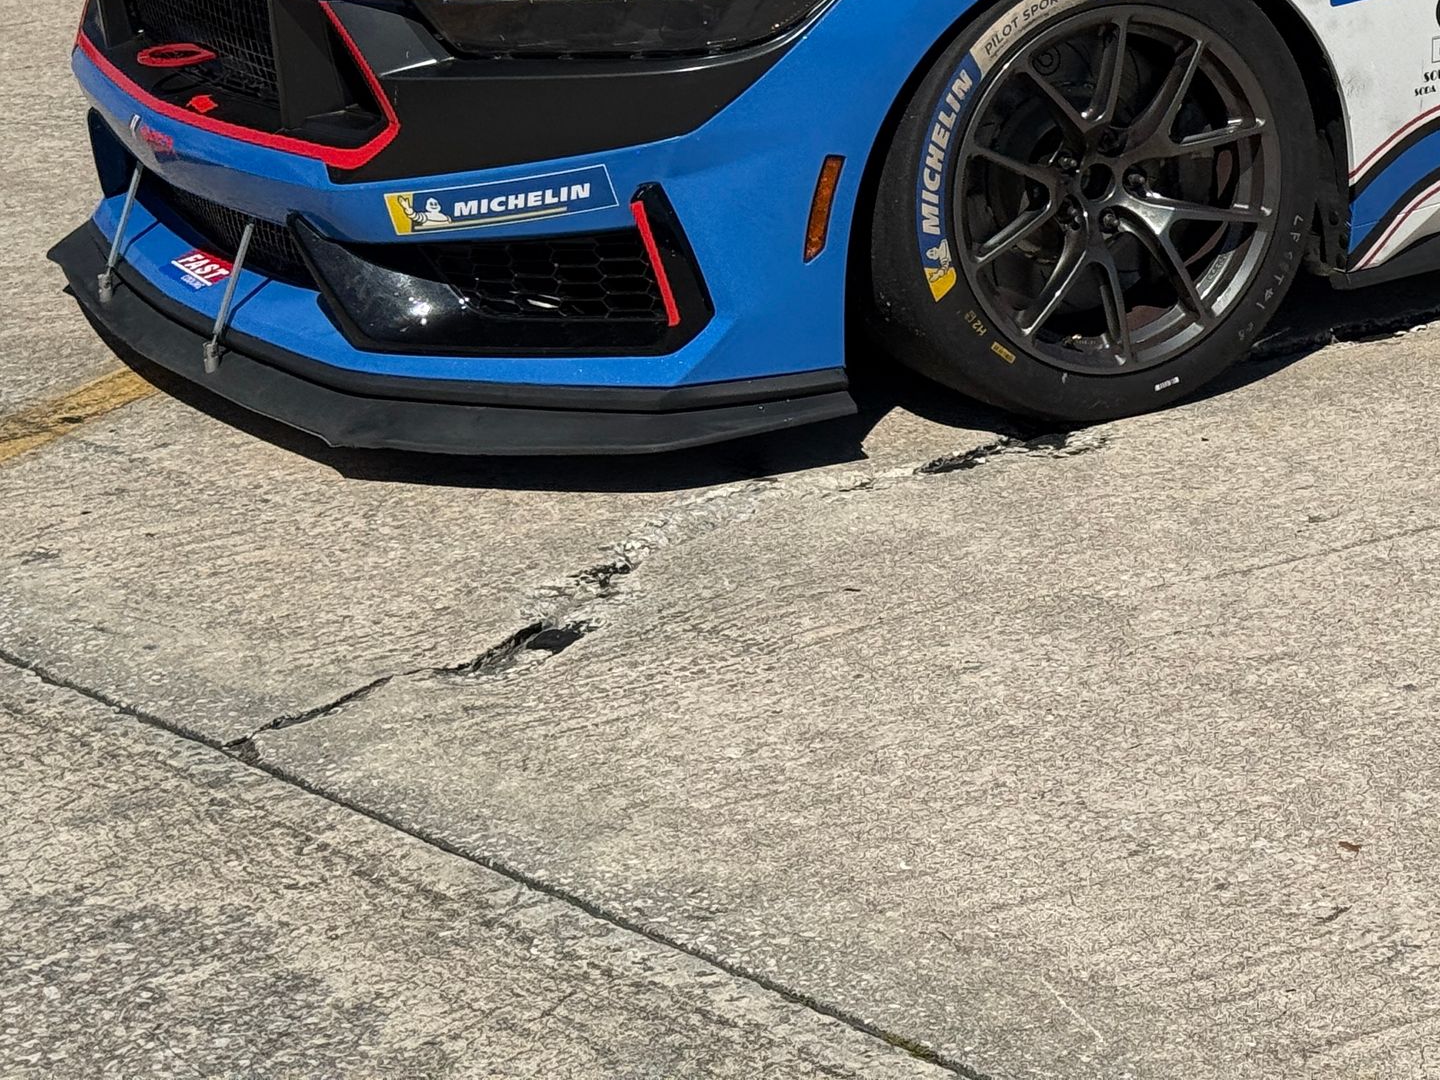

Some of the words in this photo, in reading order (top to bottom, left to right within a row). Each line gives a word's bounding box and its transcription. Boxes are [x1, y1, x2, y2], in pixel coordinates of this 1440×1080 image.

[983, 20, 1021, 56] PILOT
[1414, 85, 1437, 96] SODA
[921, 69, 973, 236] MICHELIN
[454, 183, 590, 217] MICHELIN
[178, 253, 230, 279] FAST
